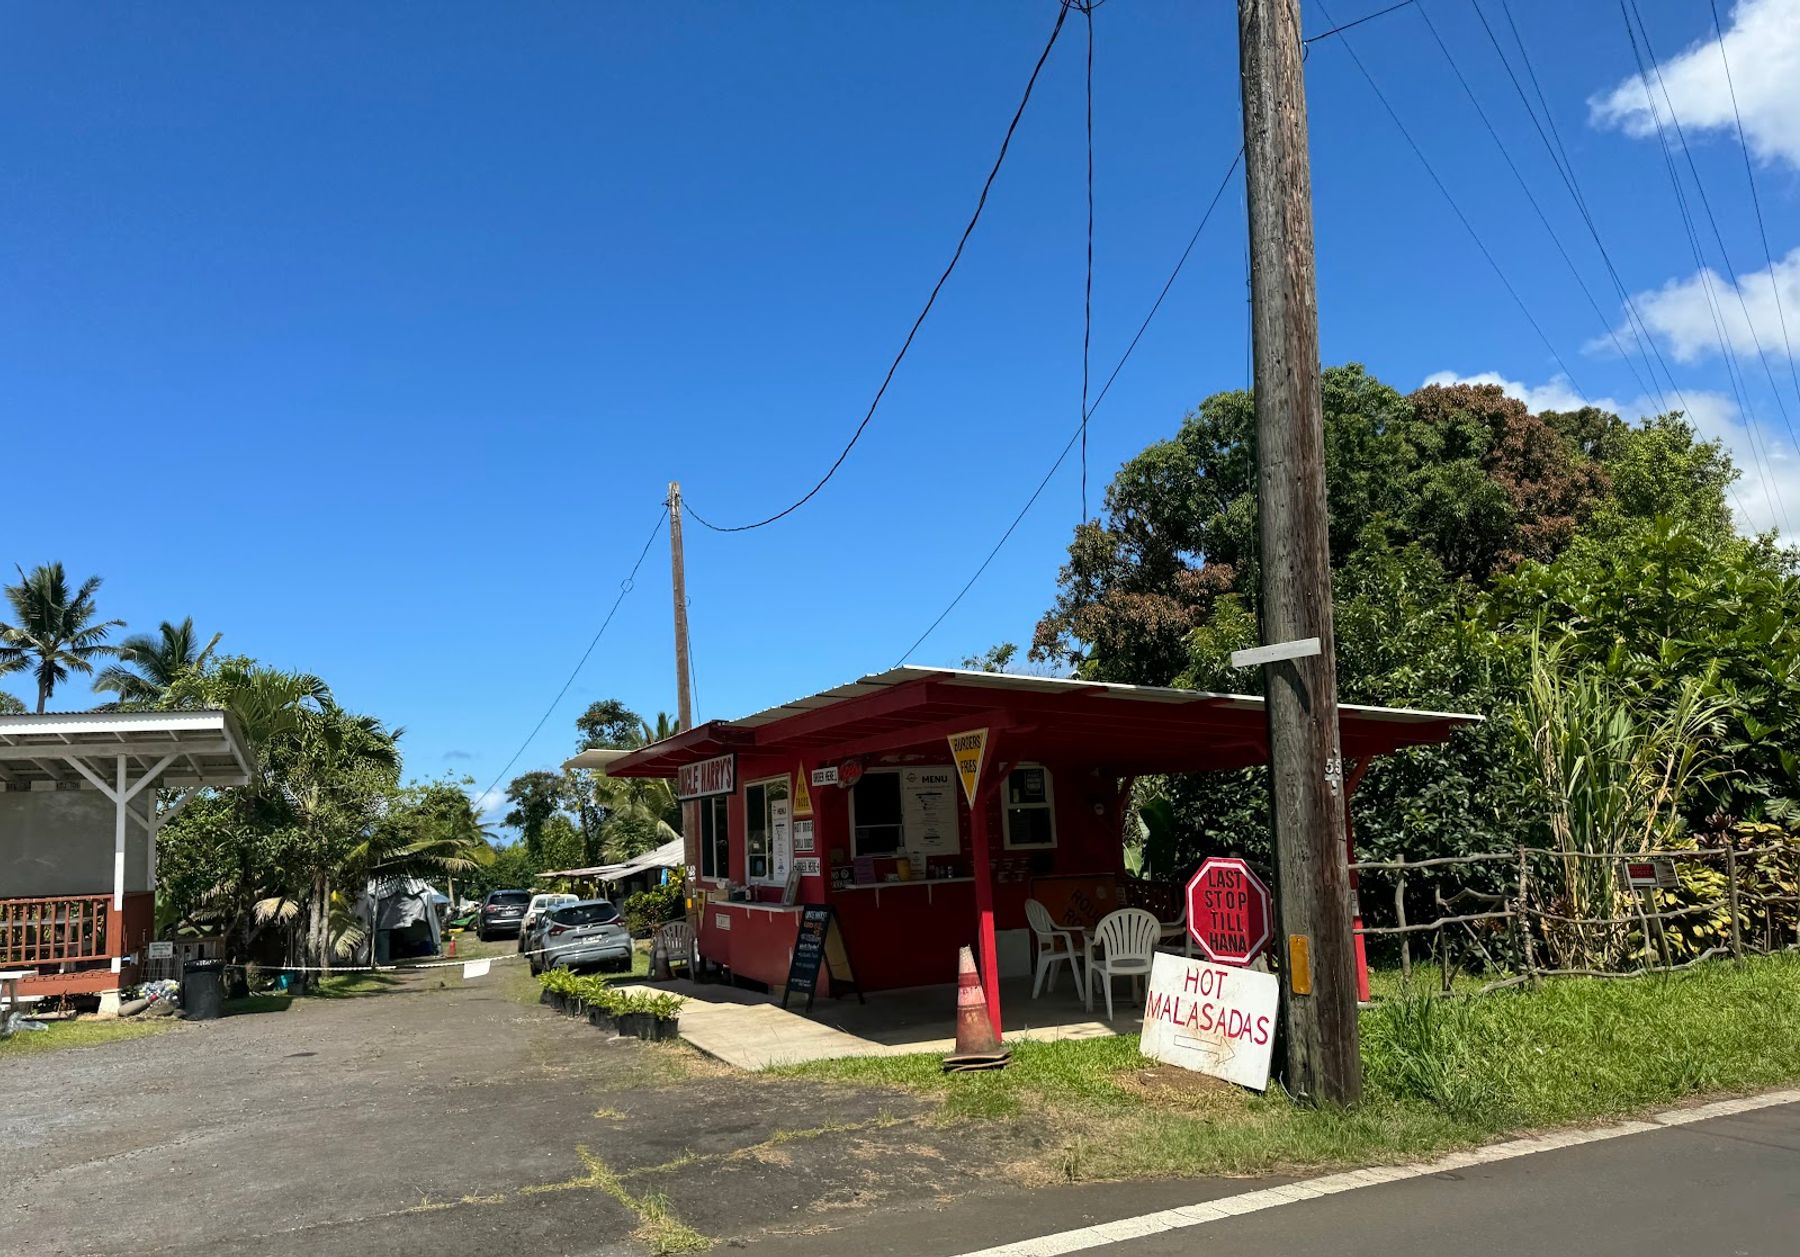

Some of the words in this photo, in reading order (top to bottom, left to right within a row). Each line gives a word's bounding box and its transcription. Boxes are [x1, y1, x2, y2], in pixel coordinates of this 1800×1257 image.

[954, 735, 981, 752] BURGERS
[701, 757, 732, 793] HARRY'S
[960, 759, 977, 774] FRIES
[922, 775, 948, 784] MENU
[1208, 869, 1242, 889] LAST
[1204, 891, 1247, 909] STOP
[1210, 911, 1245, 932] TILL
[1209, 932, 1248, 953] HANA
[1184, 967, 1228, 1000] HOT
[1146, 990, 1270, 1046] MALASADAS
